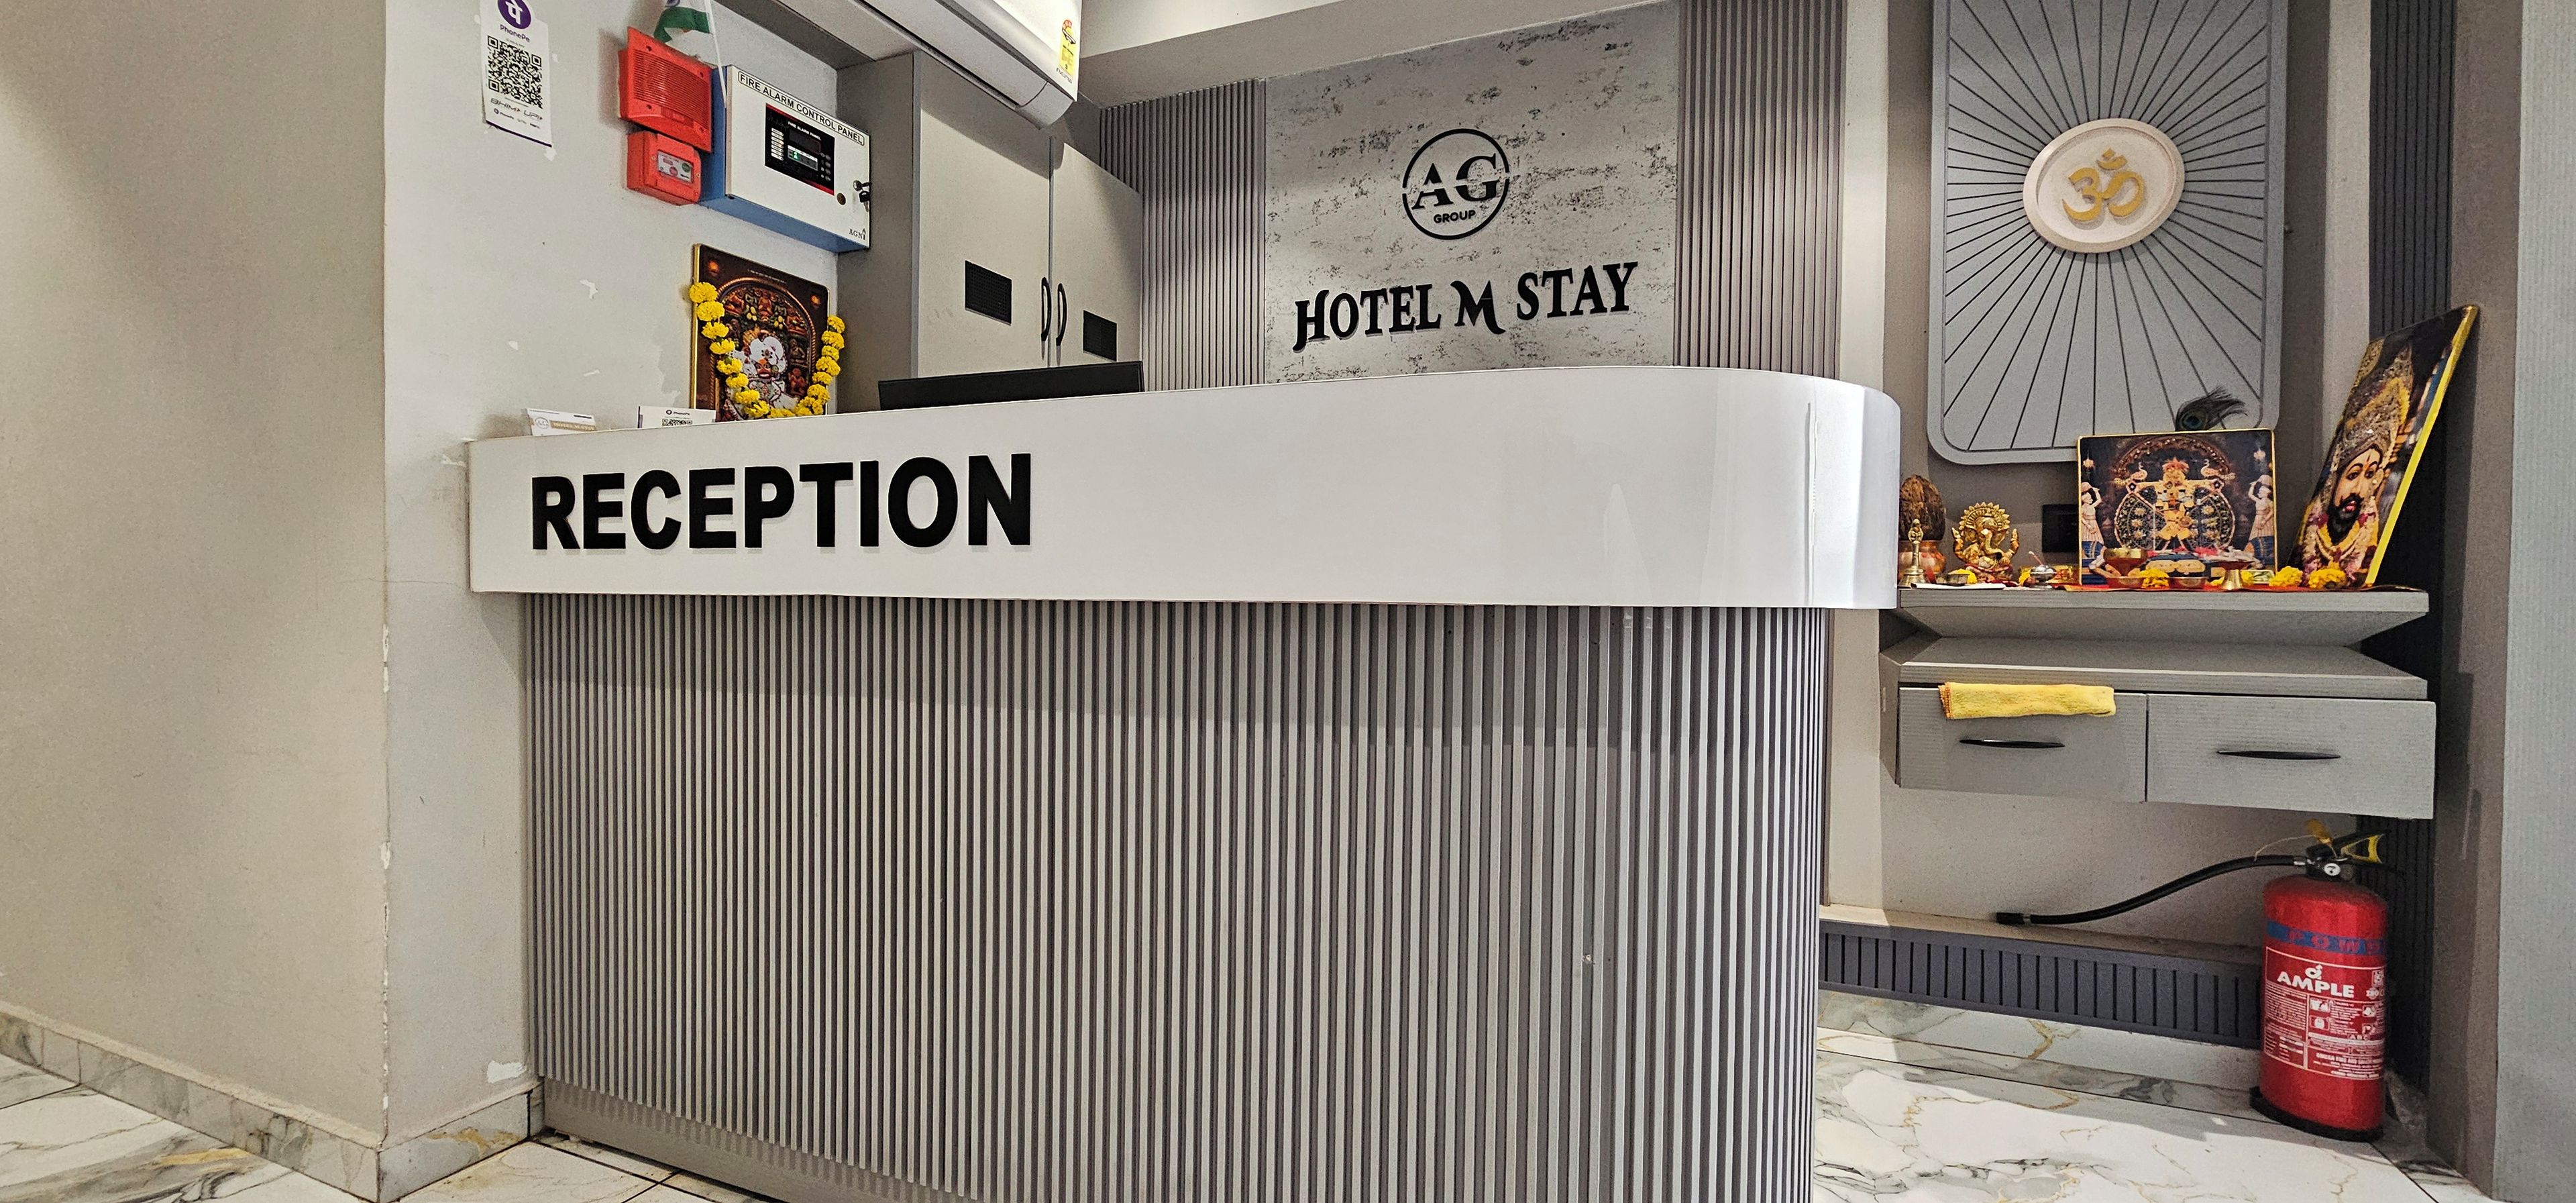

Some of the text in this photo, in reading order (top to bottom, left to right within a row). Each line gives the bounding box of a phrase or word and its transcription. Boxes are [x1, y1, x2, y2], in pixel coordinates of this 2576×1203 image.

[740, 74, 863, 145] FIRE ALARM CONTROL PANEL
[1411, 153, 1500, 210] AG
[1433, 209, 1476, 223] GROUP
[1293, 261, 1638, 352] HOTEL M STAY
[532, 453, 1031, 550] RECEPTION
[2277, 971, 2355, 998] AMPLE
